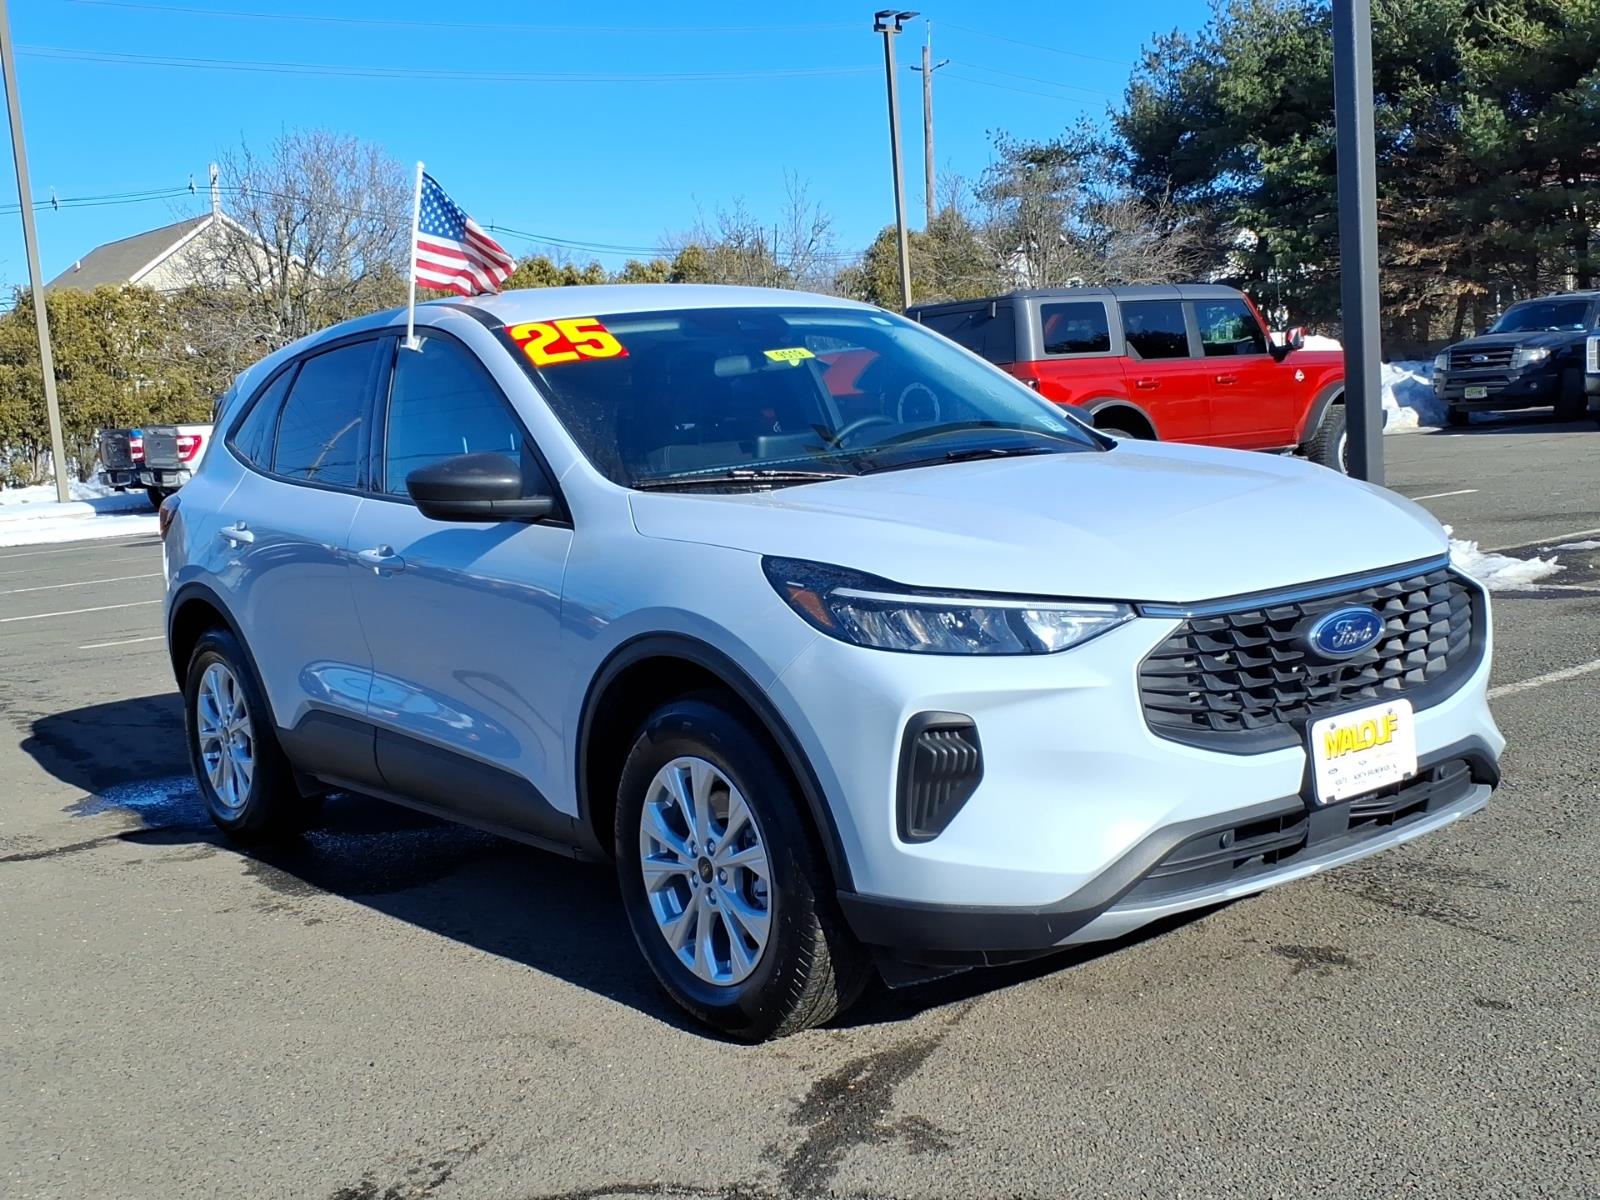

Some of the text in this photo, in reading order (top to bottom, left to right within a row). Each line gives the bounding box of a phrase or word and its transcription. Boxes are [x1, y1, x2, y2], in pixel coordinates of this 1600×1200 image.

[510, 317, 623, 366] 25
[1332, 618, 1372, 648] Ford
[1323, 713, 1398, 760] MALOUF
